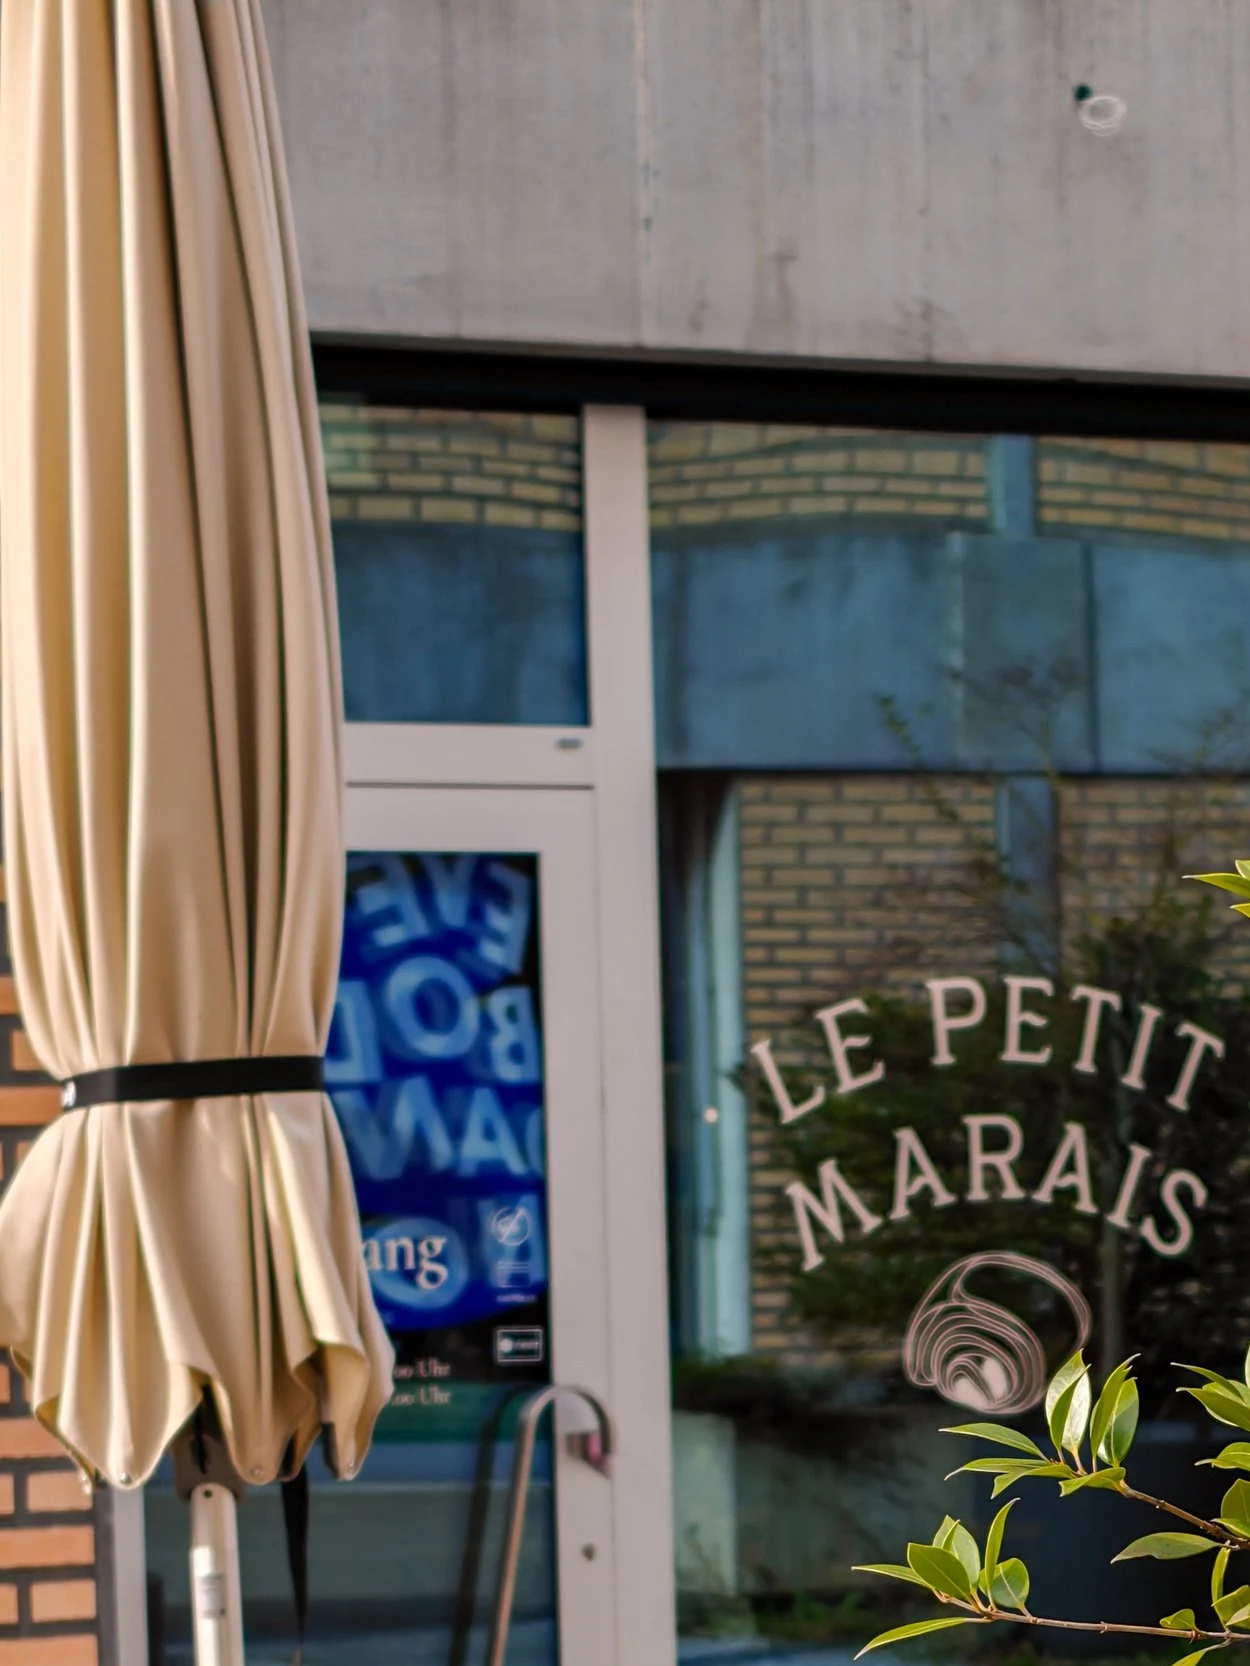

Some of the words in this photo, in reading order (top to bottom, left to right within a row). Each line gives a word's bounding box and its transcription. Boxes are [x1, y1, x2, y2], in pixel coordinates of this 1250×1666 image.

[751, 998, 886, 1124] LE
[926, 975, 1225, 1113] PETIT
[784, 1113, 1209, 1272] MARAIS
[417, 1357, 451, 1378] Uhr
[419, 1382, 451, 1406] Uhr
